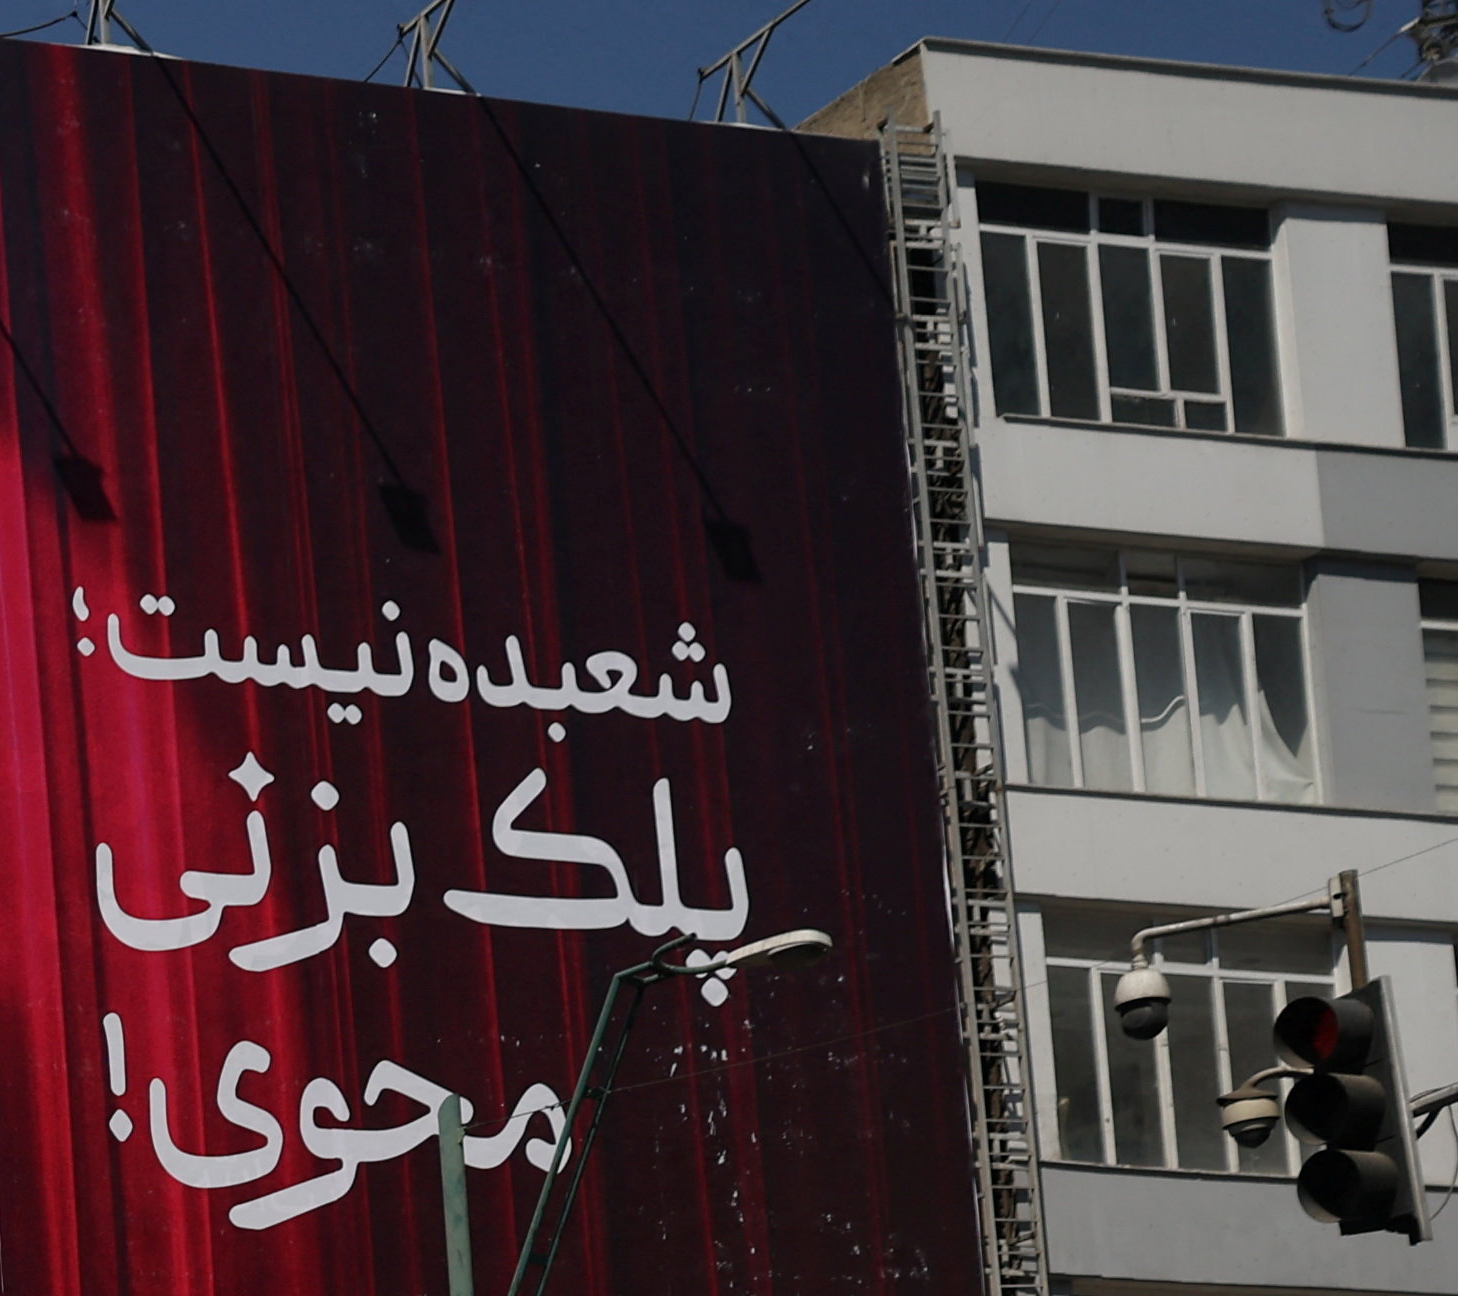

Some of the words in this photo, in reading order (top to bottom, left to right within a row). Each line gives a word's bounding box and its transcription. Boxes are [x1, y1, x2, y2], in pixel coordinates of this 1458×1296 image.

[426, 621, 733, 742] شعبده
[94, 750, 416, 973] بزنی
[442, 767, 750, 1007] پلک
